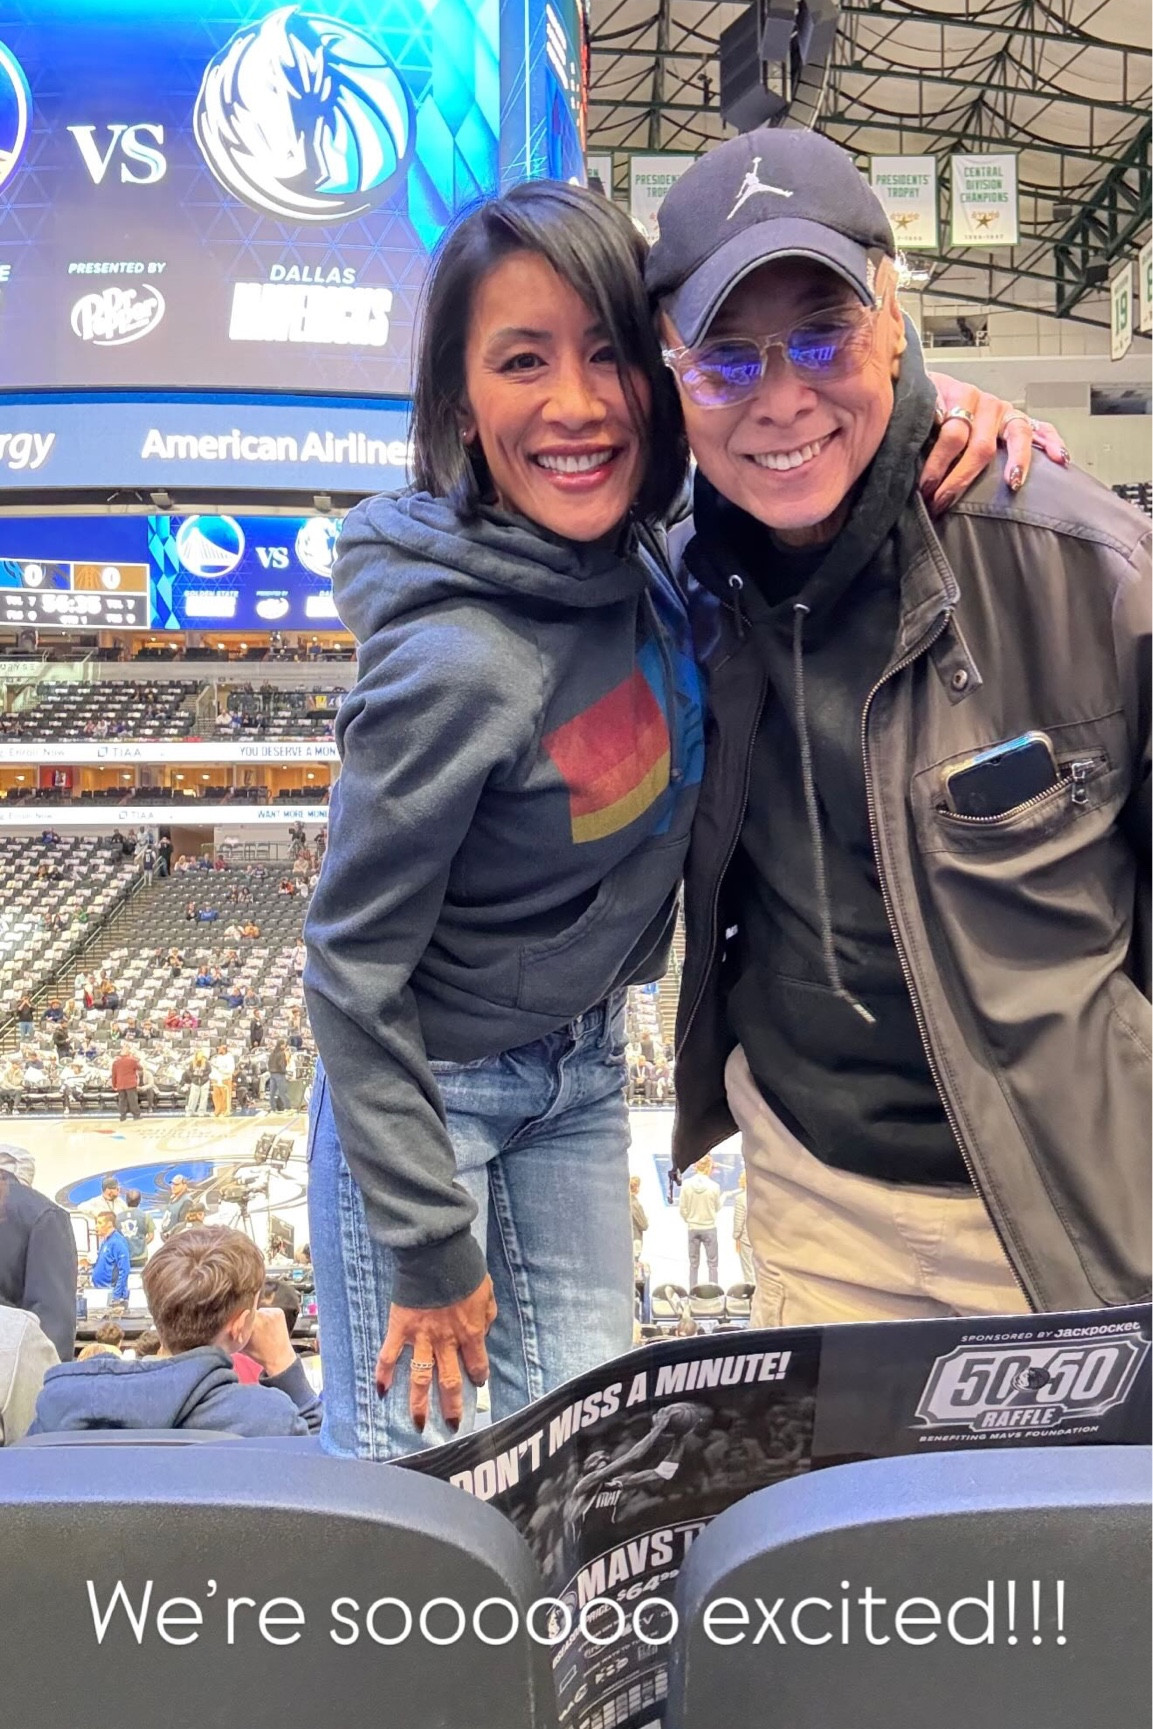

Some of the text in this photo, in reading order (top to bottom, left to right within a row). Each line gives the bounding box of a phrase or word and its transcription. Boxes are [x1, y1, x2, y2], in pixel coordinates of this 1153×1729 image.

[66, 123, 167, 184] VS
[964, 166, 1004, 177] CENTRAL
[966, 179, 1003, 190] DIVISION
[888, 187, 920, 198] TROPHY
[960, 192, 1009, 203] CHAMPIONS
[68, 262, 167, 274] PRESENTED BY
[269, 264, 356, 284] DALLAS
[141, 428, 298, 461] American
[255, 546, 290, 569] VS
[112, 748, 141, 757] TIAA
[240, 746, 259, 757] YOU
[261, 746, 302, 757] DESERVE
[306, 746, 312, 757] A
[961, 1332, 1033, 1343] SPONSORED
[1037, 1330, 1052, 1339] BY
[549, 1382, 625, 1458] MISS
[626, 1371, 647, 1408] A
[654, 1350, 792, 1397] MINUTE!
[981, 1408, 1056, 1428] RAFFLE
[919, 1425, 1099, 1443] BENEFITING MAVS FOUNDATION
[577, 1529, 674, 1609] MAVS
